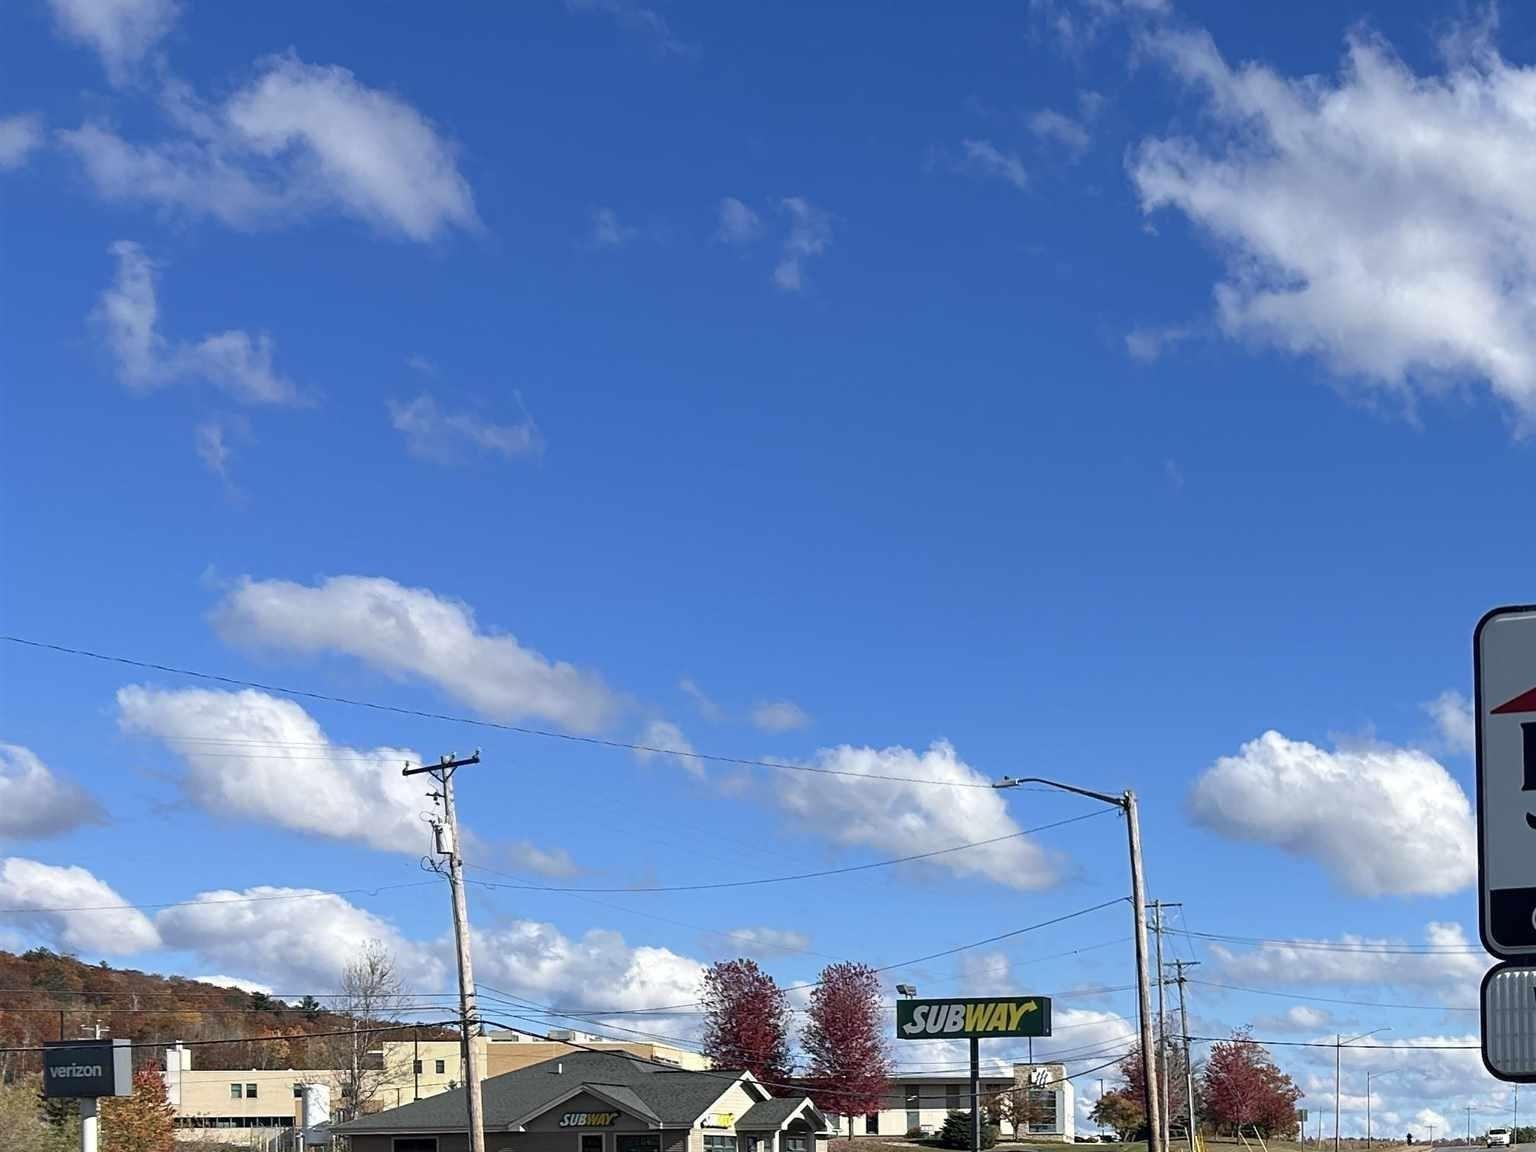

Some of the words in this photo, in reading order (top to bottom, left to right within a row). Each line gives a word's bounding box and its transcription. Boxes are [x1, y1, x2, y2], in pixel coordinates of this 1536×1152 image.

[903, 1000, 1038, 1035] SUBWAY
[50, 1062, 103, 1078] verizon
[560, 1112, 619, 1127] SUBWAY
